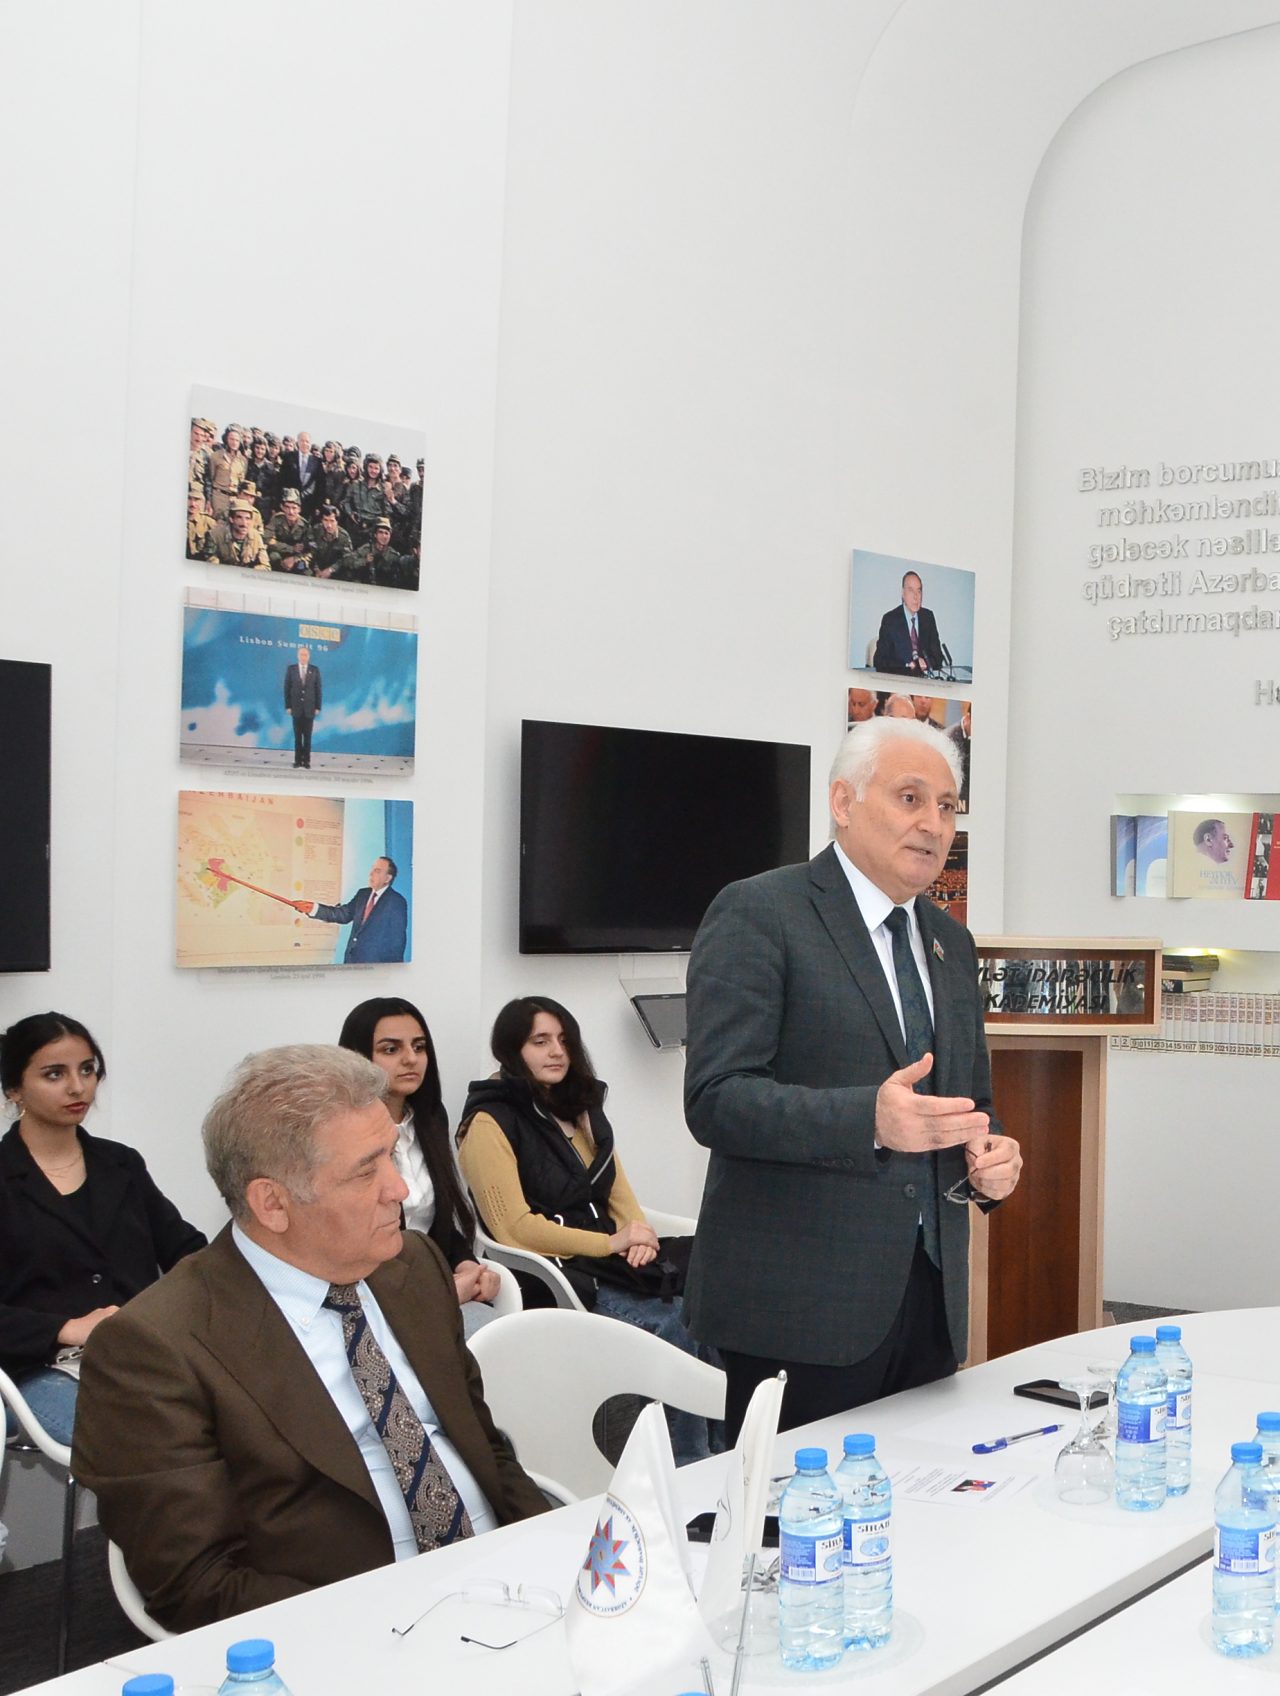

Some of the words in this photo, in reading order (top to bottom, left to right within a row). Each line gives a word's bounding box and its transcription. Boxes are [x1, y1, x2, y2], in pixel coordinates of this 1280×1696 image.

[1078, 466, 1150, 493] Bizim
[1087, 533, 1188, 568] gələcək
[1081, 570, 1181, 605] qüdrətli
[240, 635, 273, 646] Lisbon
